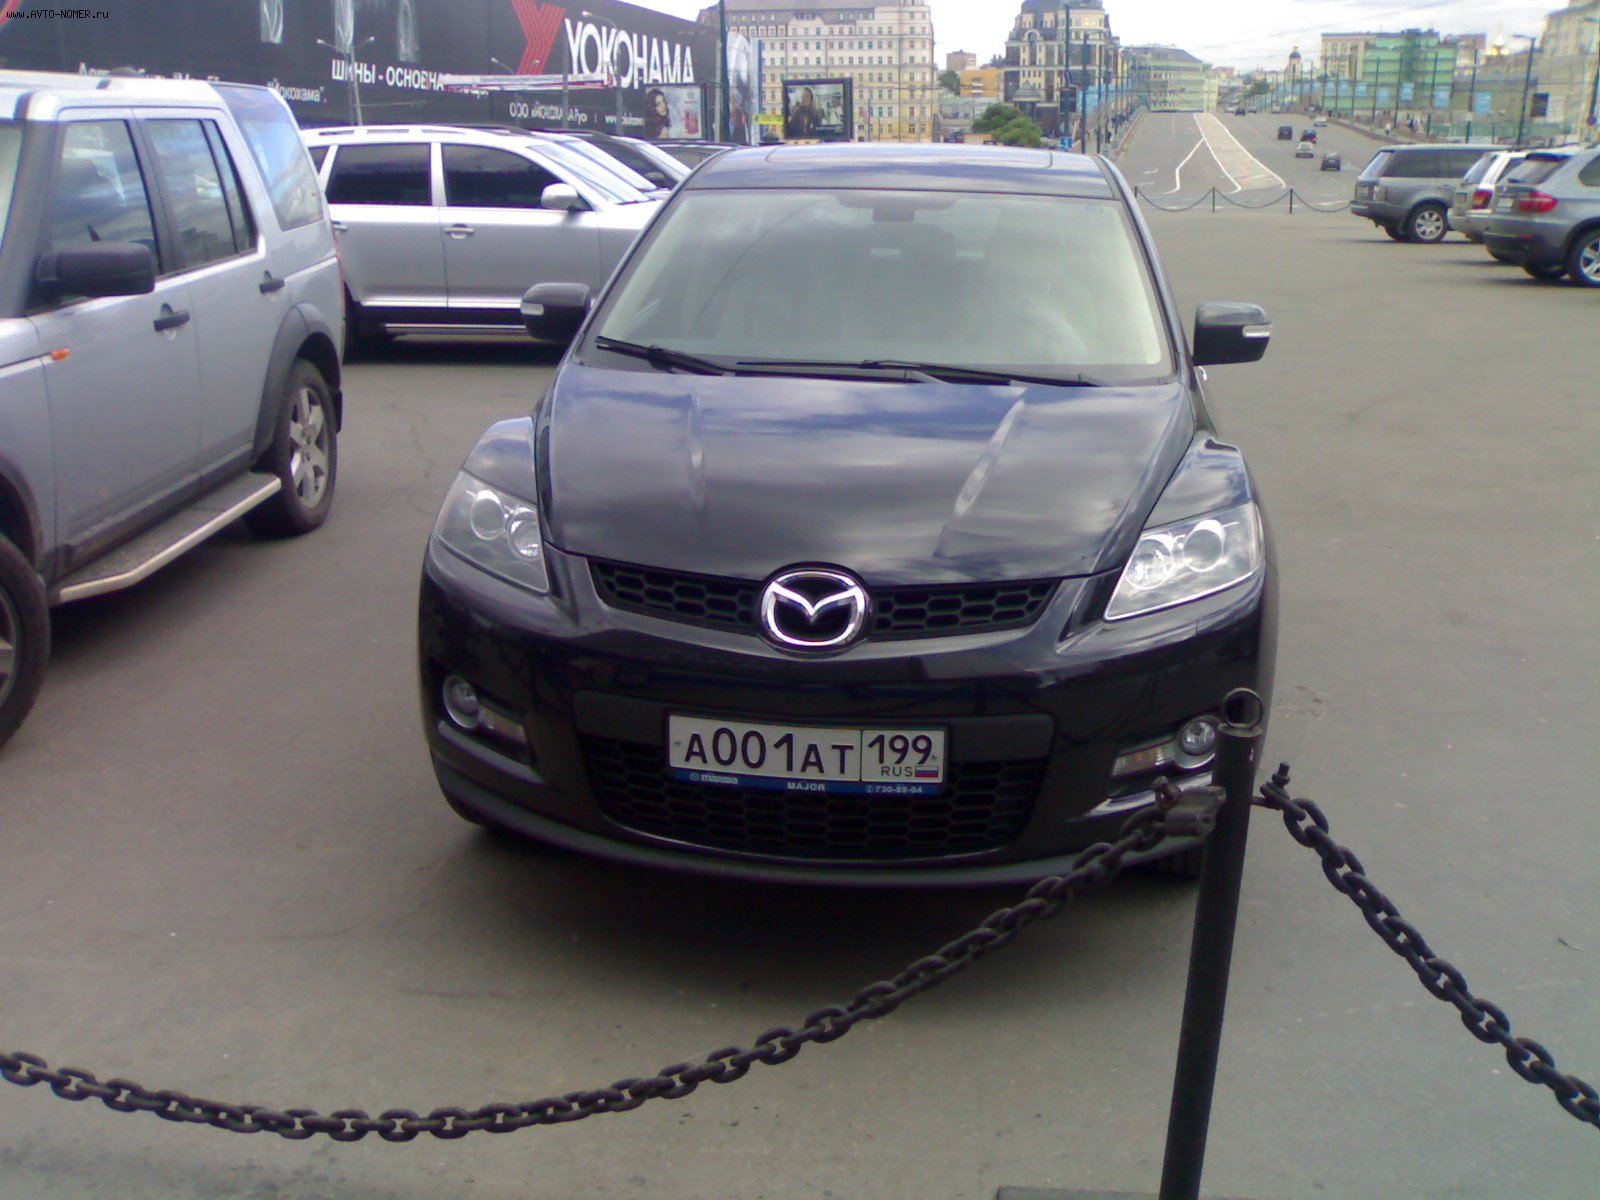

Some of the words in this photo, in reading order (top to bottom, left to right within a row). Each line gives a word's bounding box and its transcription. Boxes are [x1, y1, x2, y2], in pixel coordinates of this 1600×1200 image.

[564, 18, 694, 90] YOKOHAMA
[331, 59, 376, 84] ШИНЫ
[386, 66, 446, 91] ОСНОВНА
[684, 727, 854, 774] А001АТ
[867, 734, 932, 765] 199
[787, 781, 825, 792] MAJOR
[880, 766, 913, 777] RUS
